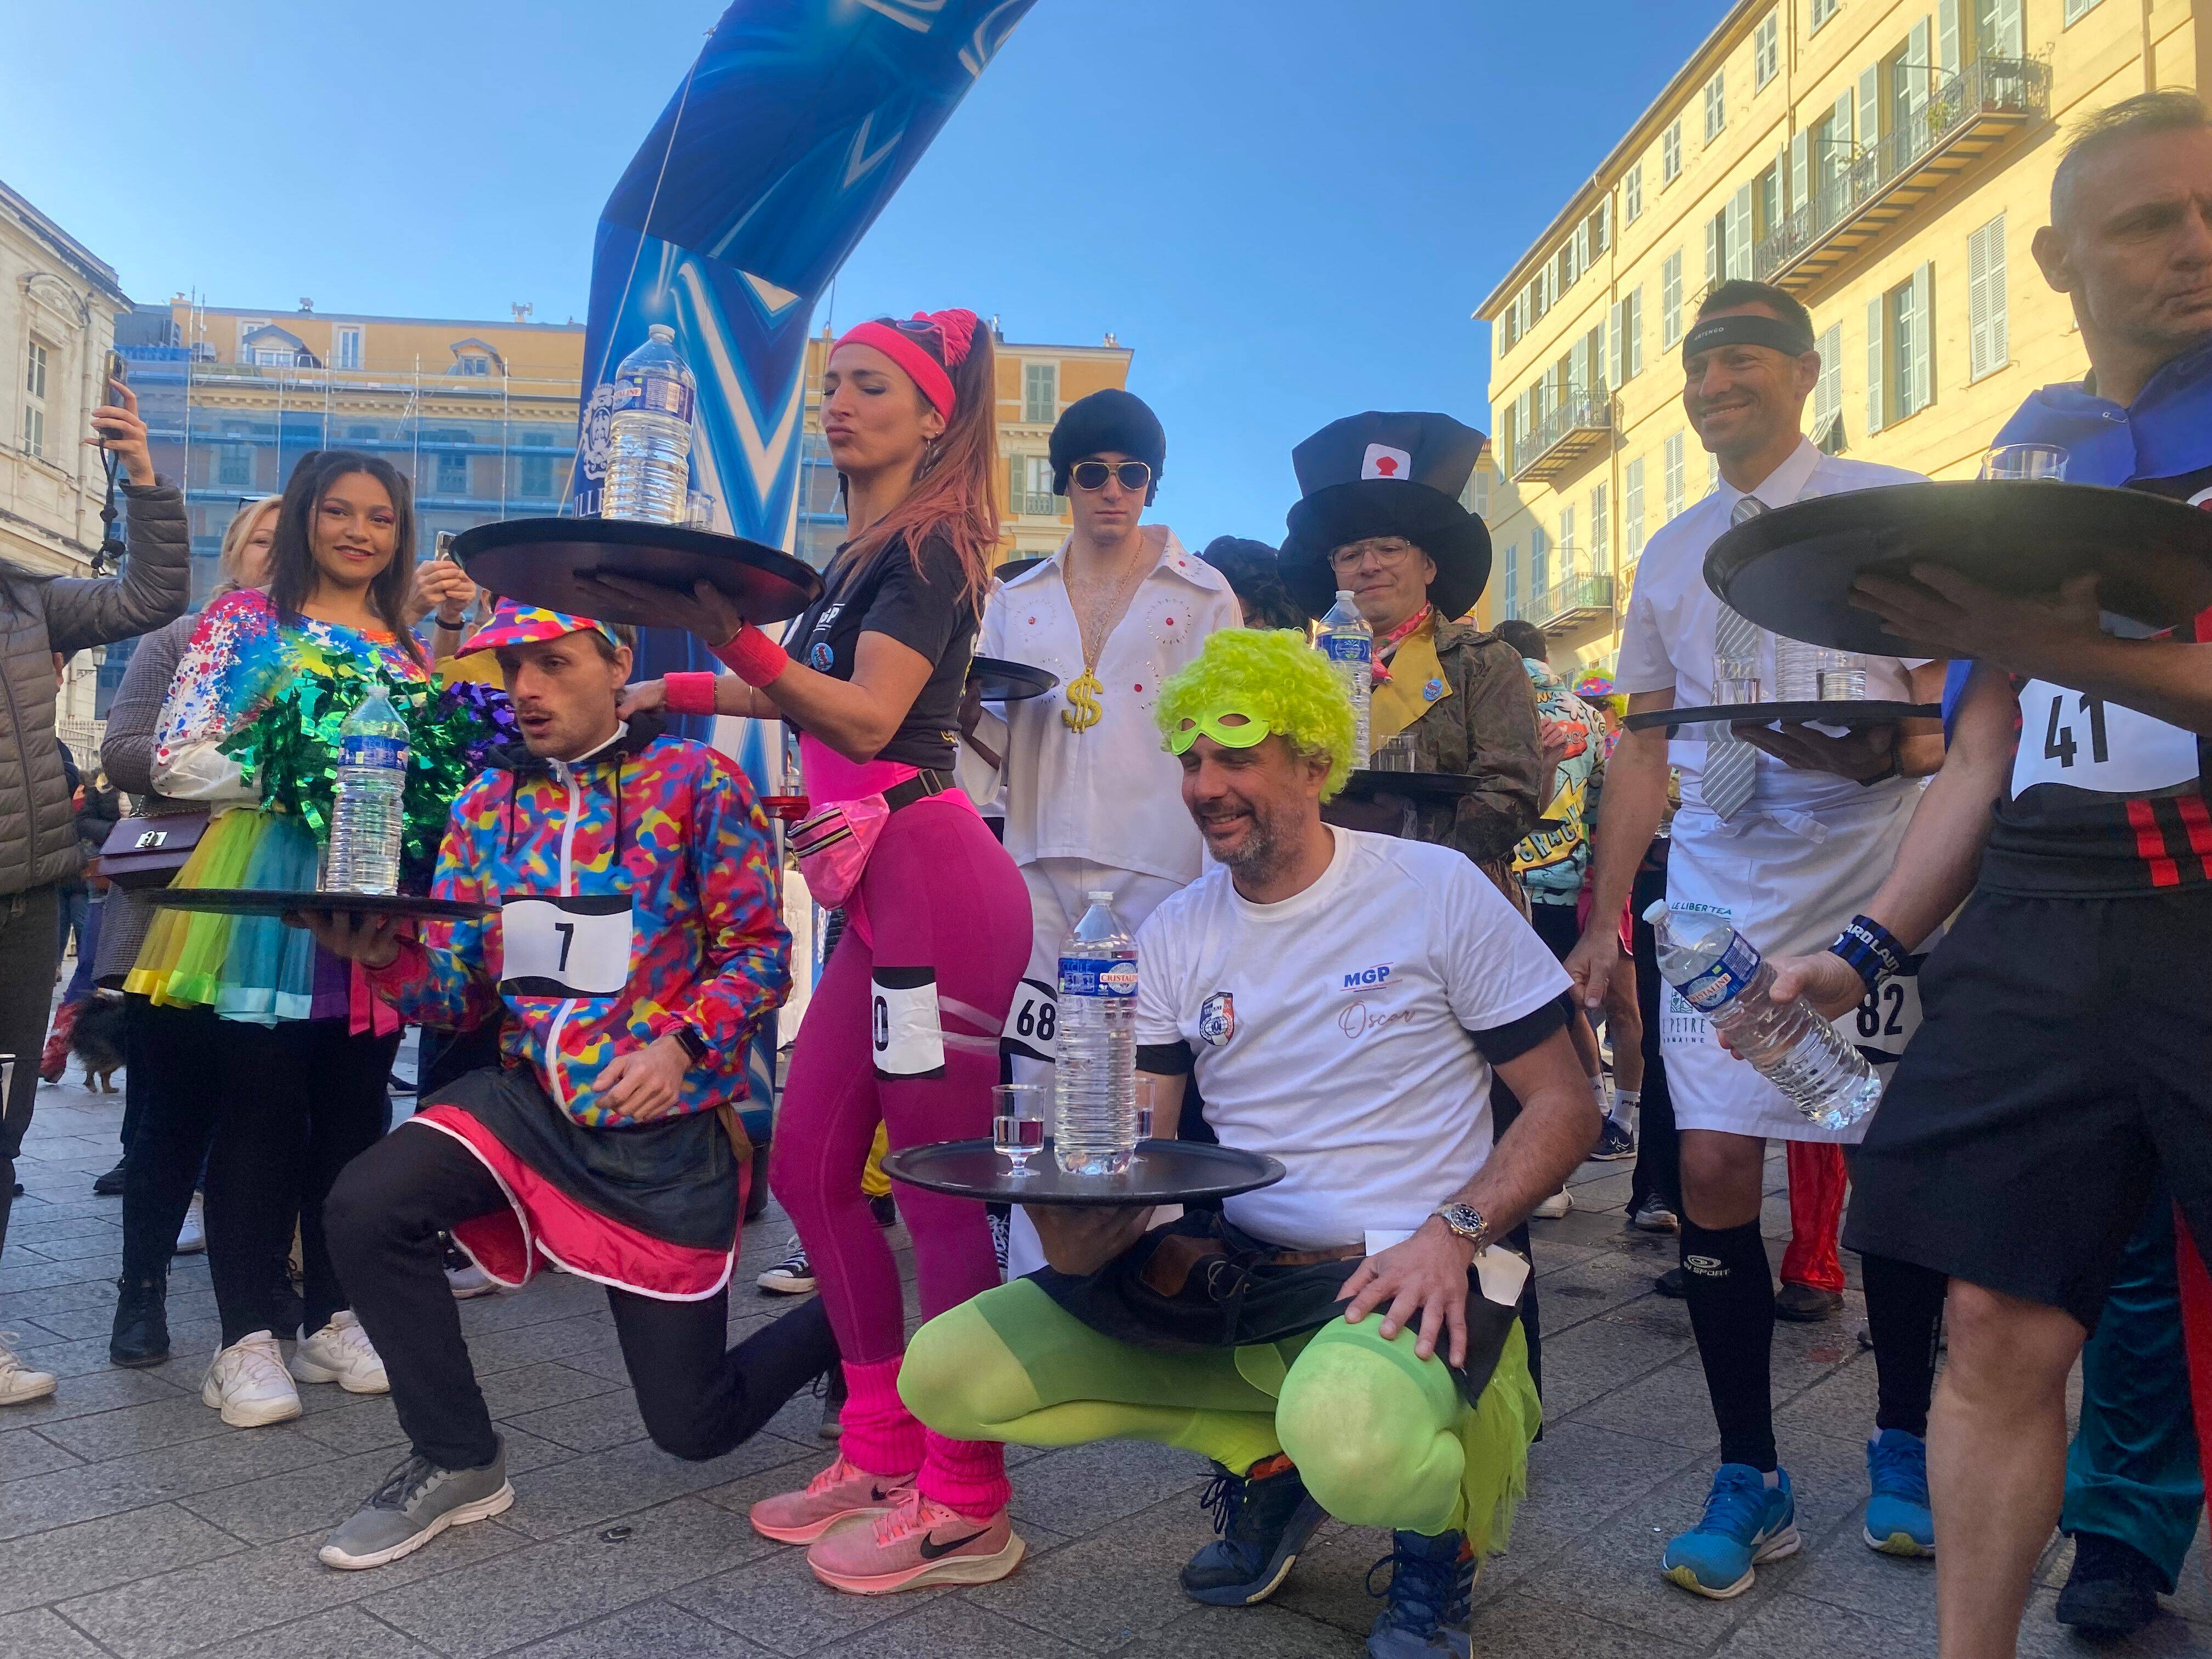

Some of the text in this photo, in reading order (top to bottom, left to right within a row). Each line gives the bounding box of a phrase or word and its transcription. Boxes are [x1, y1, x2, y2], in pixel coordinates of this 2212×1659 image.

[1694, 327, 1724, 341] ARTENGO
[2045, 693, 2109, 768] 41
[555, 922, 574, 972] 7
[1344, 966, 1390, 987] MGP
[1017, 999, 1056, 1041] 68
[1857, 983, 1904, 1038] 82
